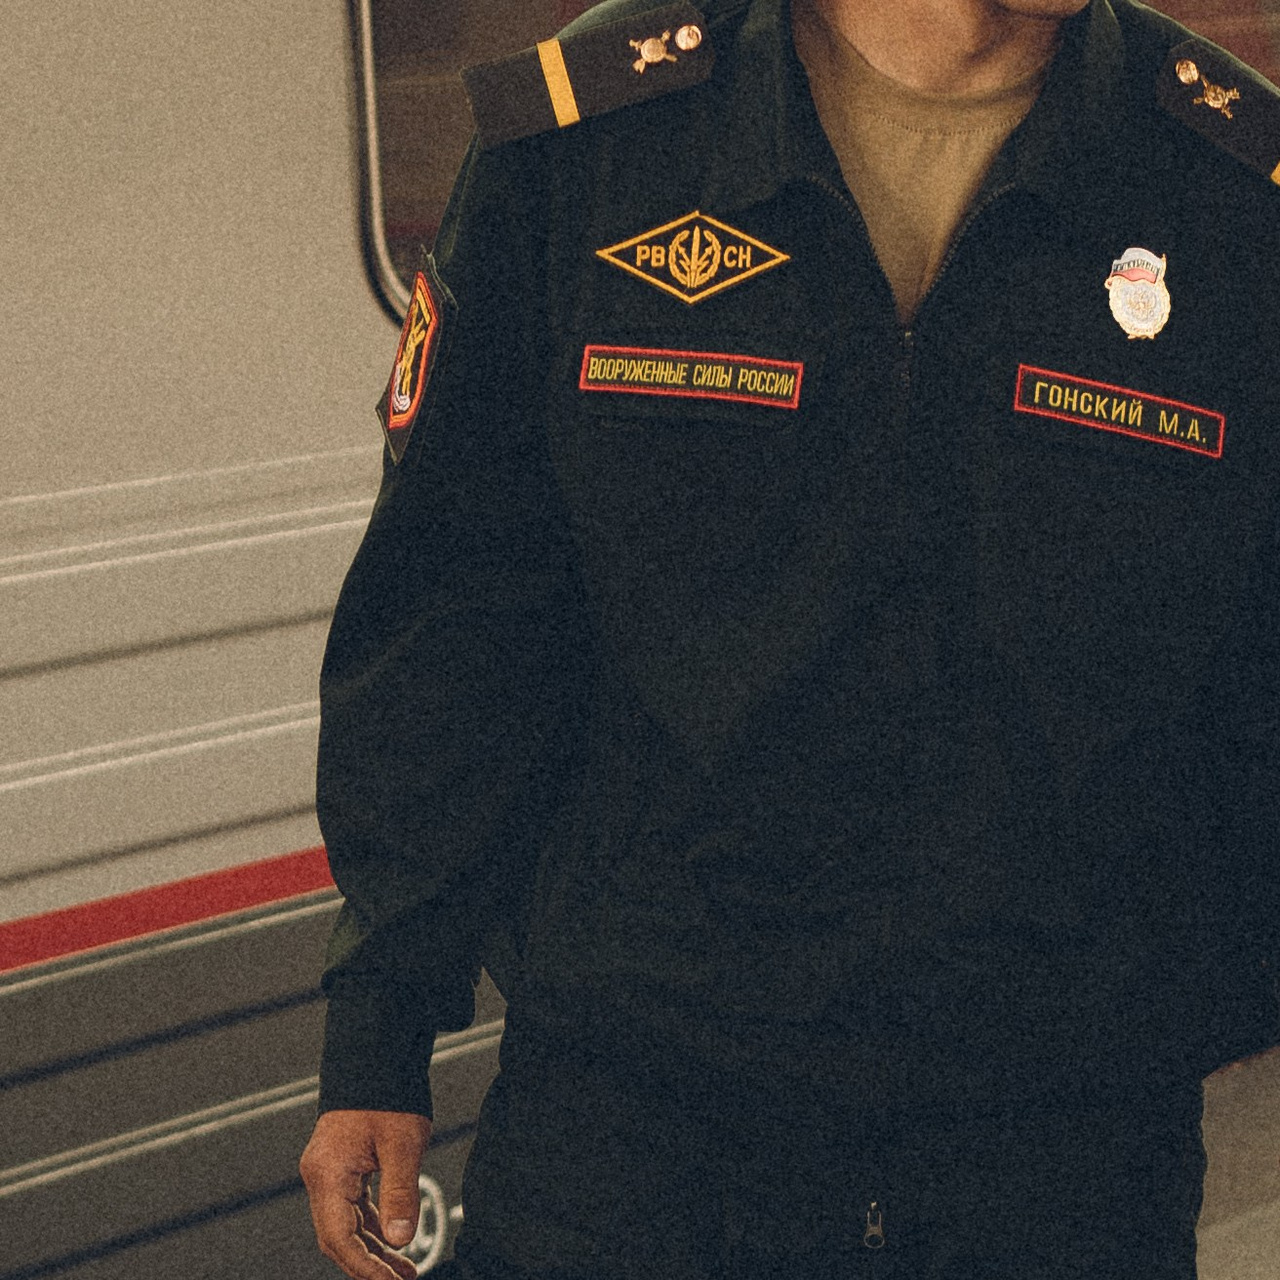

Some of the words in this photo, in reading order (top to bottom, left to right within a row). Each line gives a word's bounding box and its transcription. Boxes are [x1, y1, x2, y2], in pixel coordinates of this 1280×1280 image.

[636, 245, 666, 268] РВ
[723, 245, 751, 268] СН
[588, 357, 689, 385] ВООРУЖЕННЫЕ
[693, 364, 732, 388] СИЛЫ
[737, 368, 795, 397] РОССИИ
[1034, 381, 1144, 427] ГОНСКИЙ
[1158, 410, 1207, 444] М.А.
